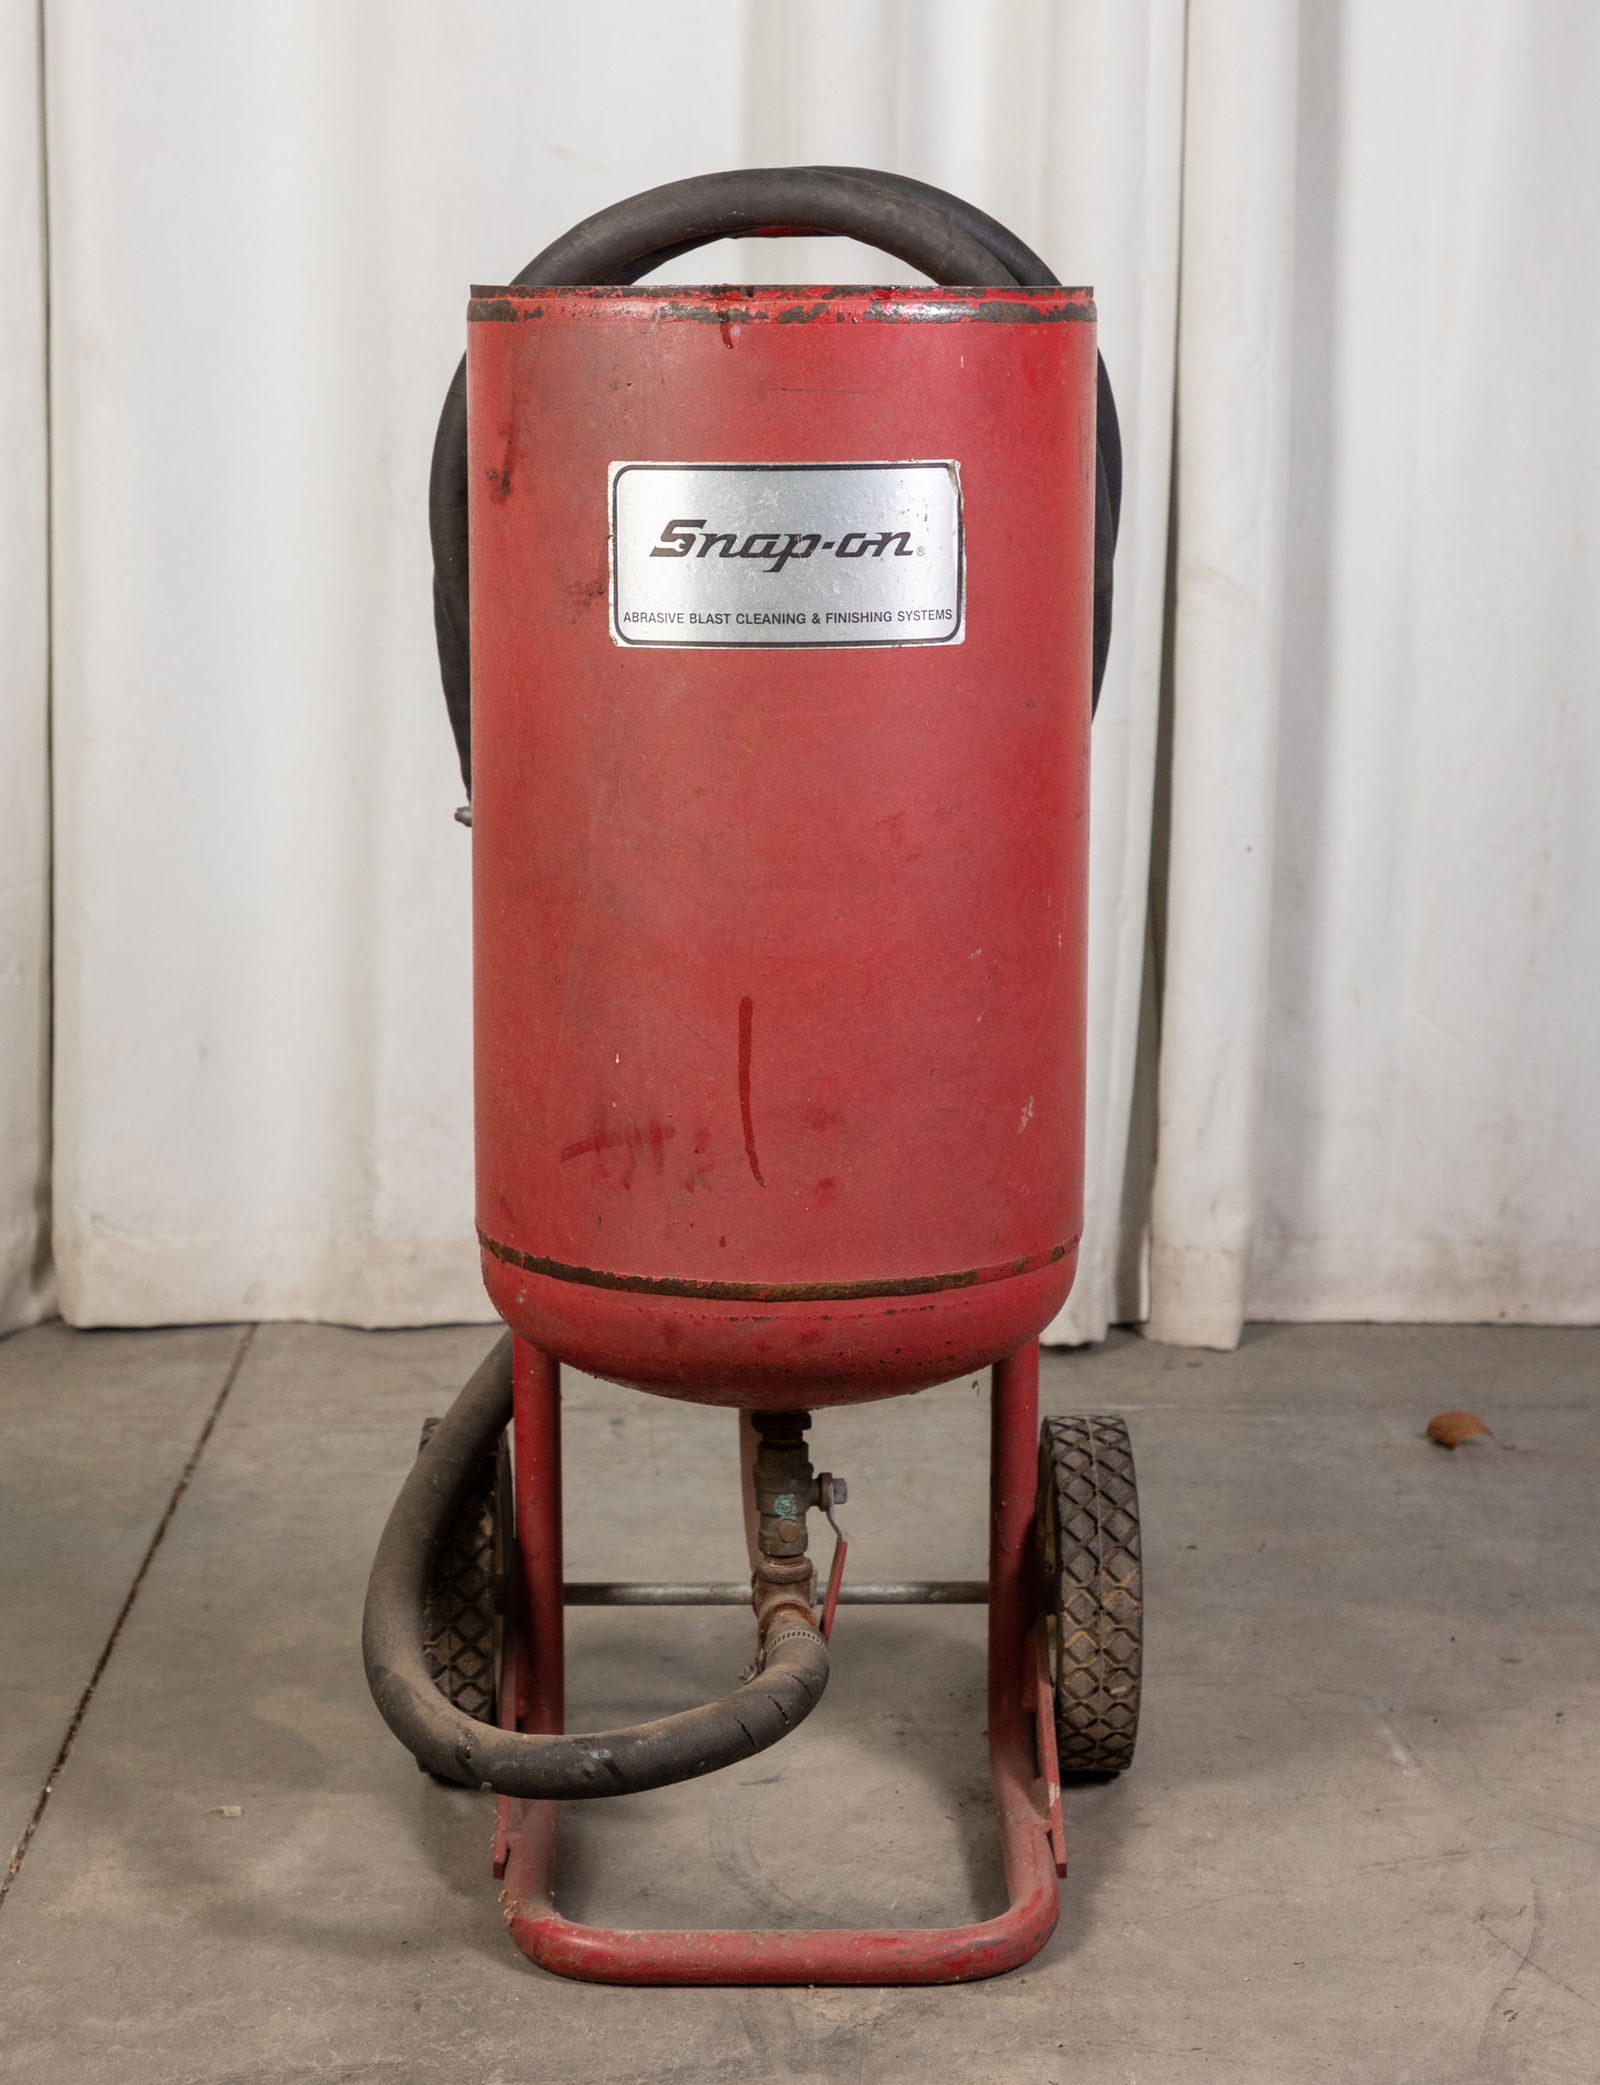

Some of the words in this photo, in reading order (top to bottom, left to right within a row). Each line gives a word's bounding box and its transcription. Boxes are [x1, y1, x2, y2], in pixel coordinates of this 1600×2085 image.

[623, 611, 685, 624] ABRASIVE
[689, 613, 732, 625] BLAST
[735, 613, 806, 625] CLEANING
[811, 613, 821, 624] &
[825, 611, 893, 624] FINISHING
[897, 608, 953, 622] SYSTEMS
